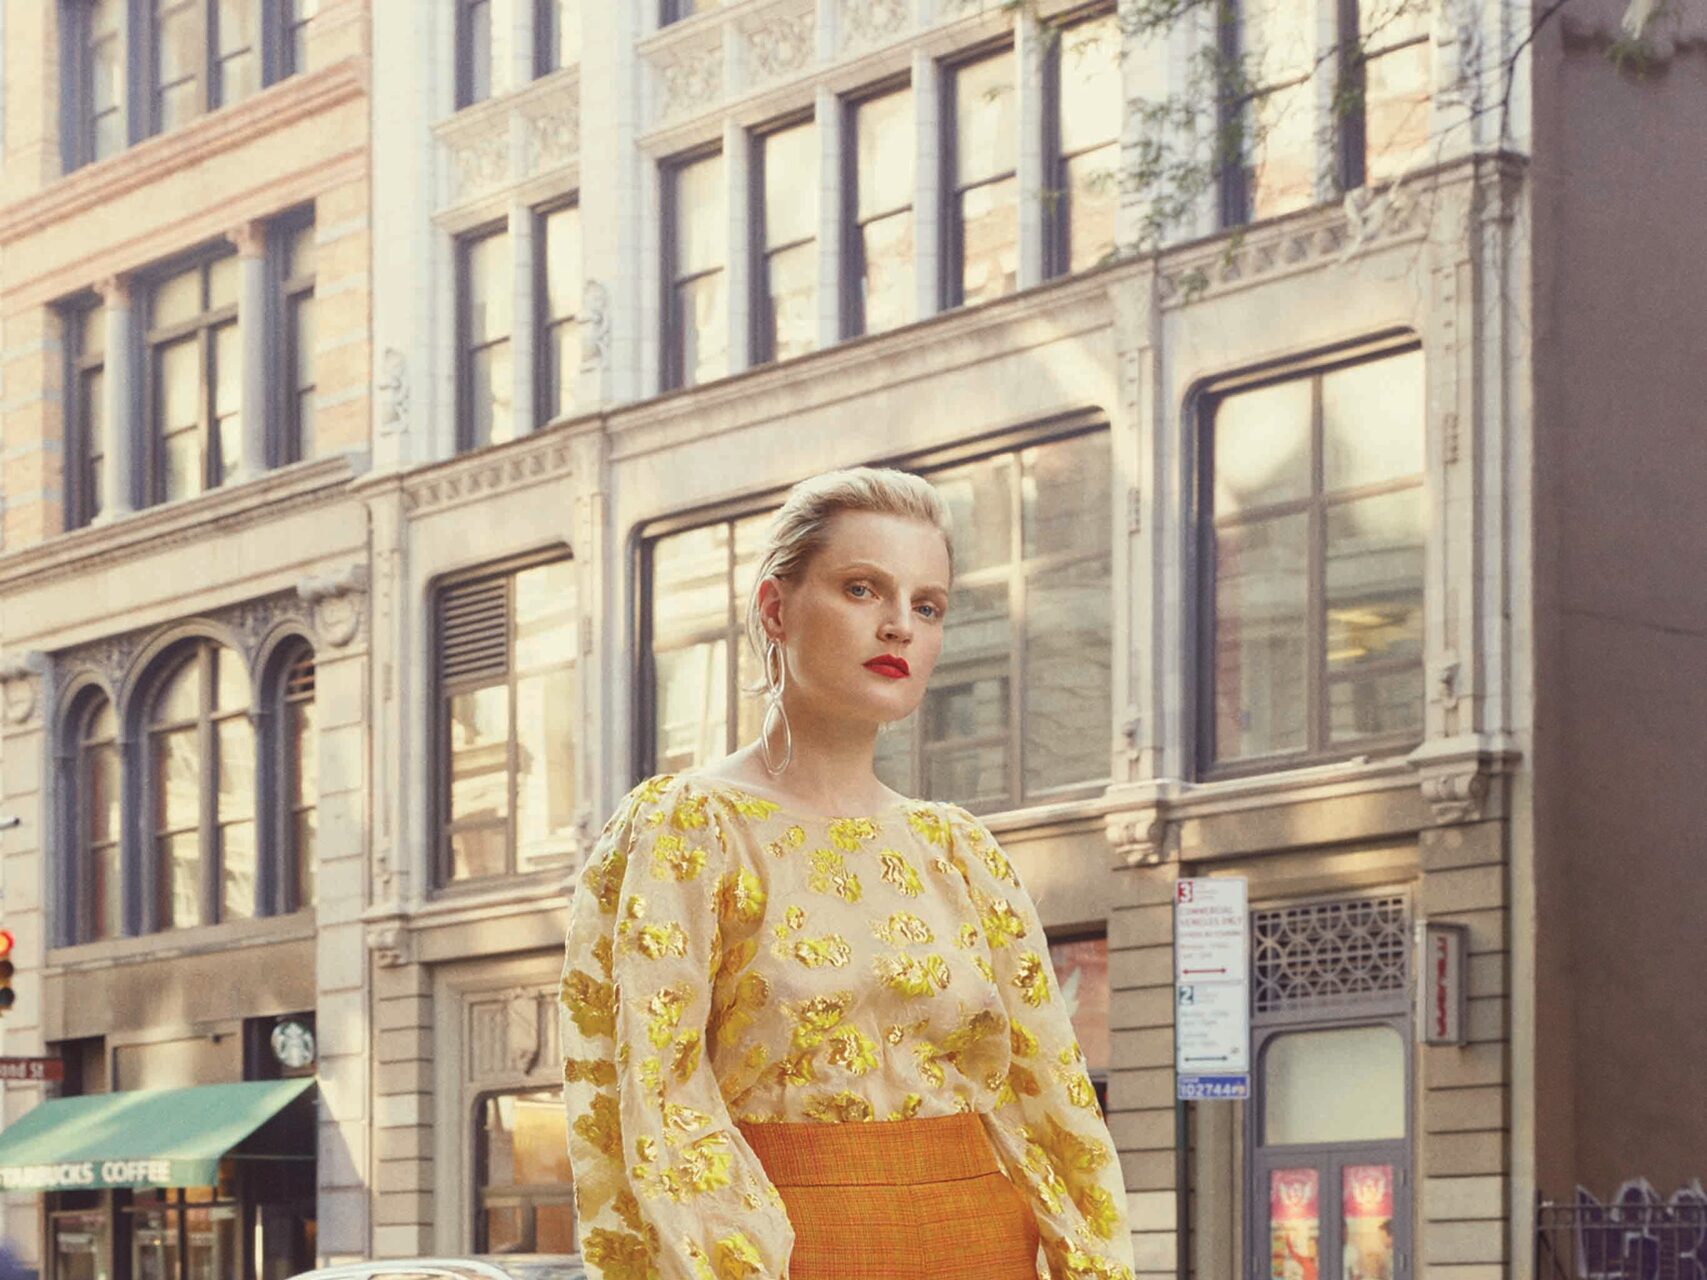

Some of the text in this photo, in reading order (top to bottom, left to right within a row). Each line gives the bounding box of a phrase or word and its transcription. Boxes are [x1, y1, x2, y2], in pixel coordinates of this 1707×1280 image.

[1180, 883, 1191, 902] 3
[1181, 987, 1191, 1004] 2
[0, 1160, 171, 1187] TARBUCKS COFFEE
